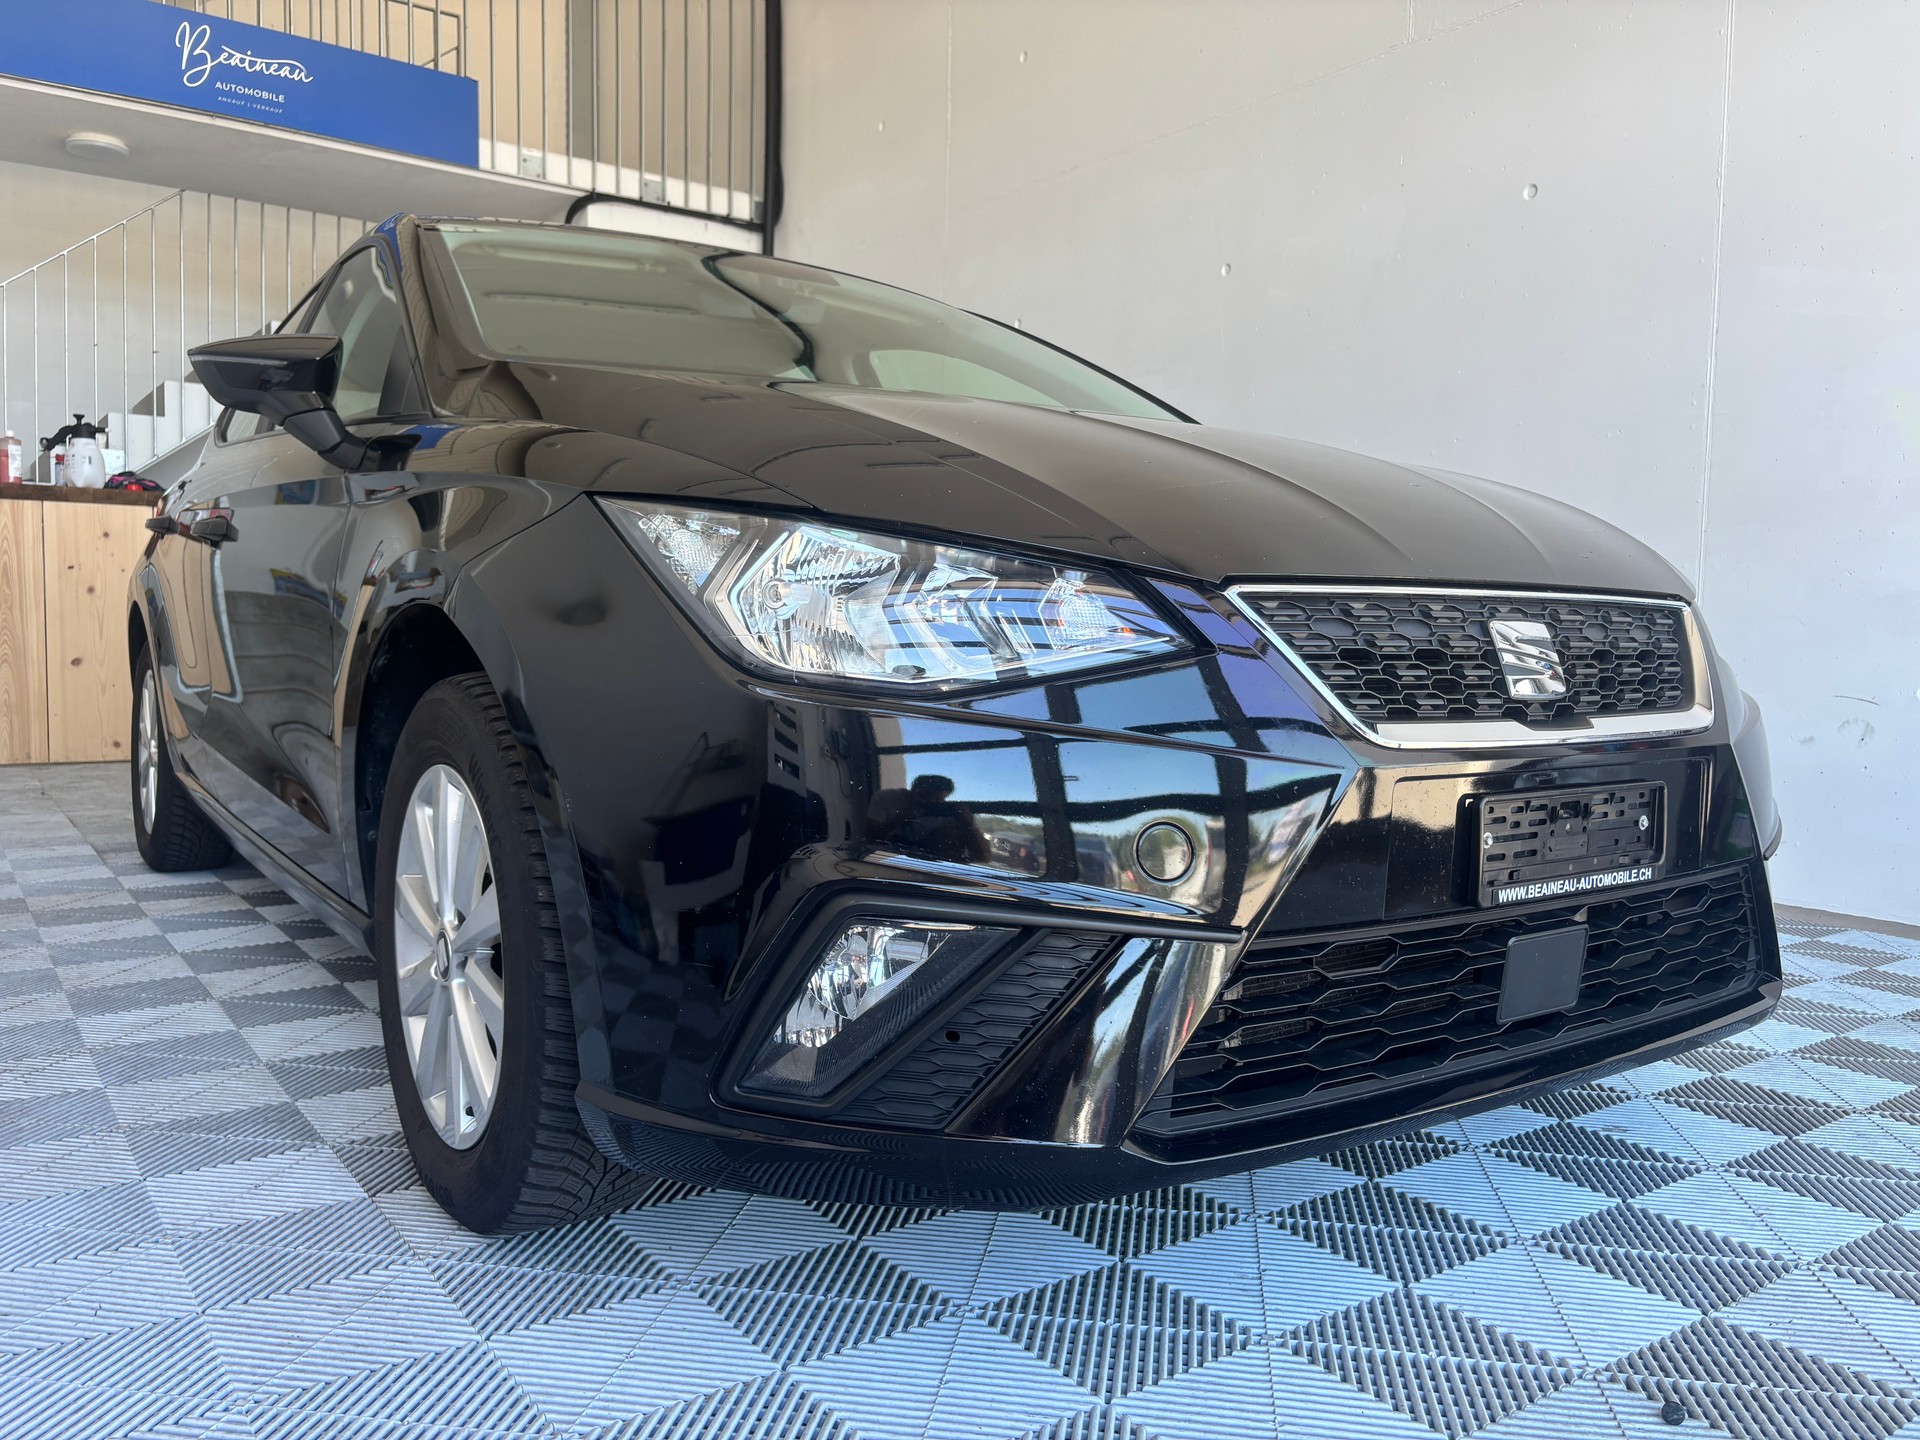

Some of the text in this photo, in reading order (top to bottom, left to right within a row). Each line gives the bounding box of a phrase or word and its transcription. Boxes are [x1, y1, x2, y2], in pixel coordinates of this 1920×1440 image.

[175, 21, 314, 88] Beaineau
[214, 80, 286, 104] AUTOMOBILE
[217, 95, 245, 106] ANKAUF
[252, 103, 283, 114] VERKAUF
[1498, 867, 1652, 903] WWW.BEAINEAU-AUTOMOBILE.CH
